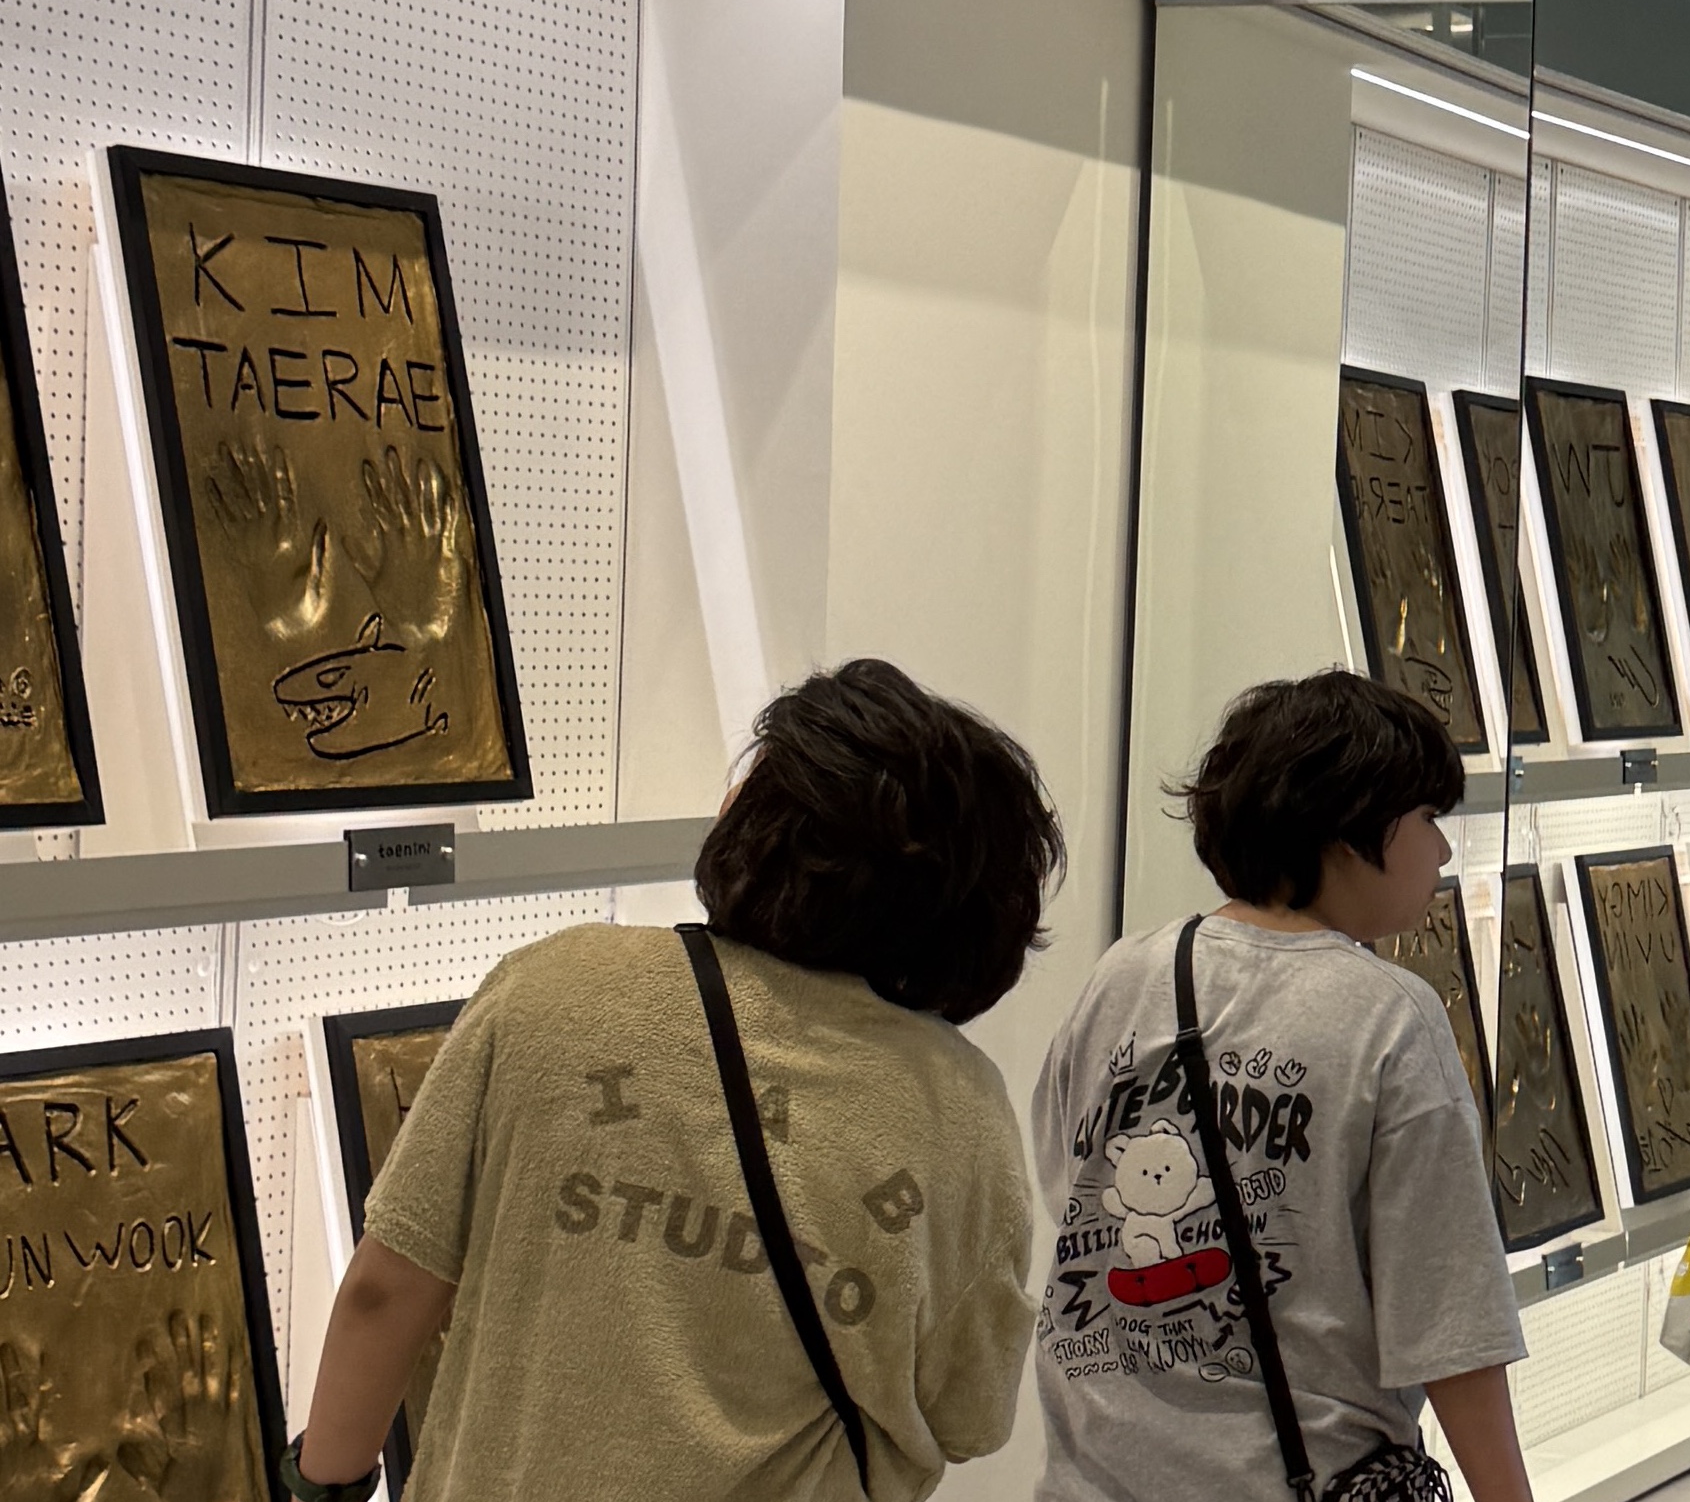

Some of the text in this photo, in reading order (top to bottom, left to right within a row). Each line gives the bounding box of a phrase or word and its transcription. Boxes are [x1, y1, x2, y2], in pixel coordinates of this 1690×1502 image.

[188, 222, 414, 324] KIM
[172, 336, 446, 433] TAERAE
[555, 1172, 877, 1327] STUDO
